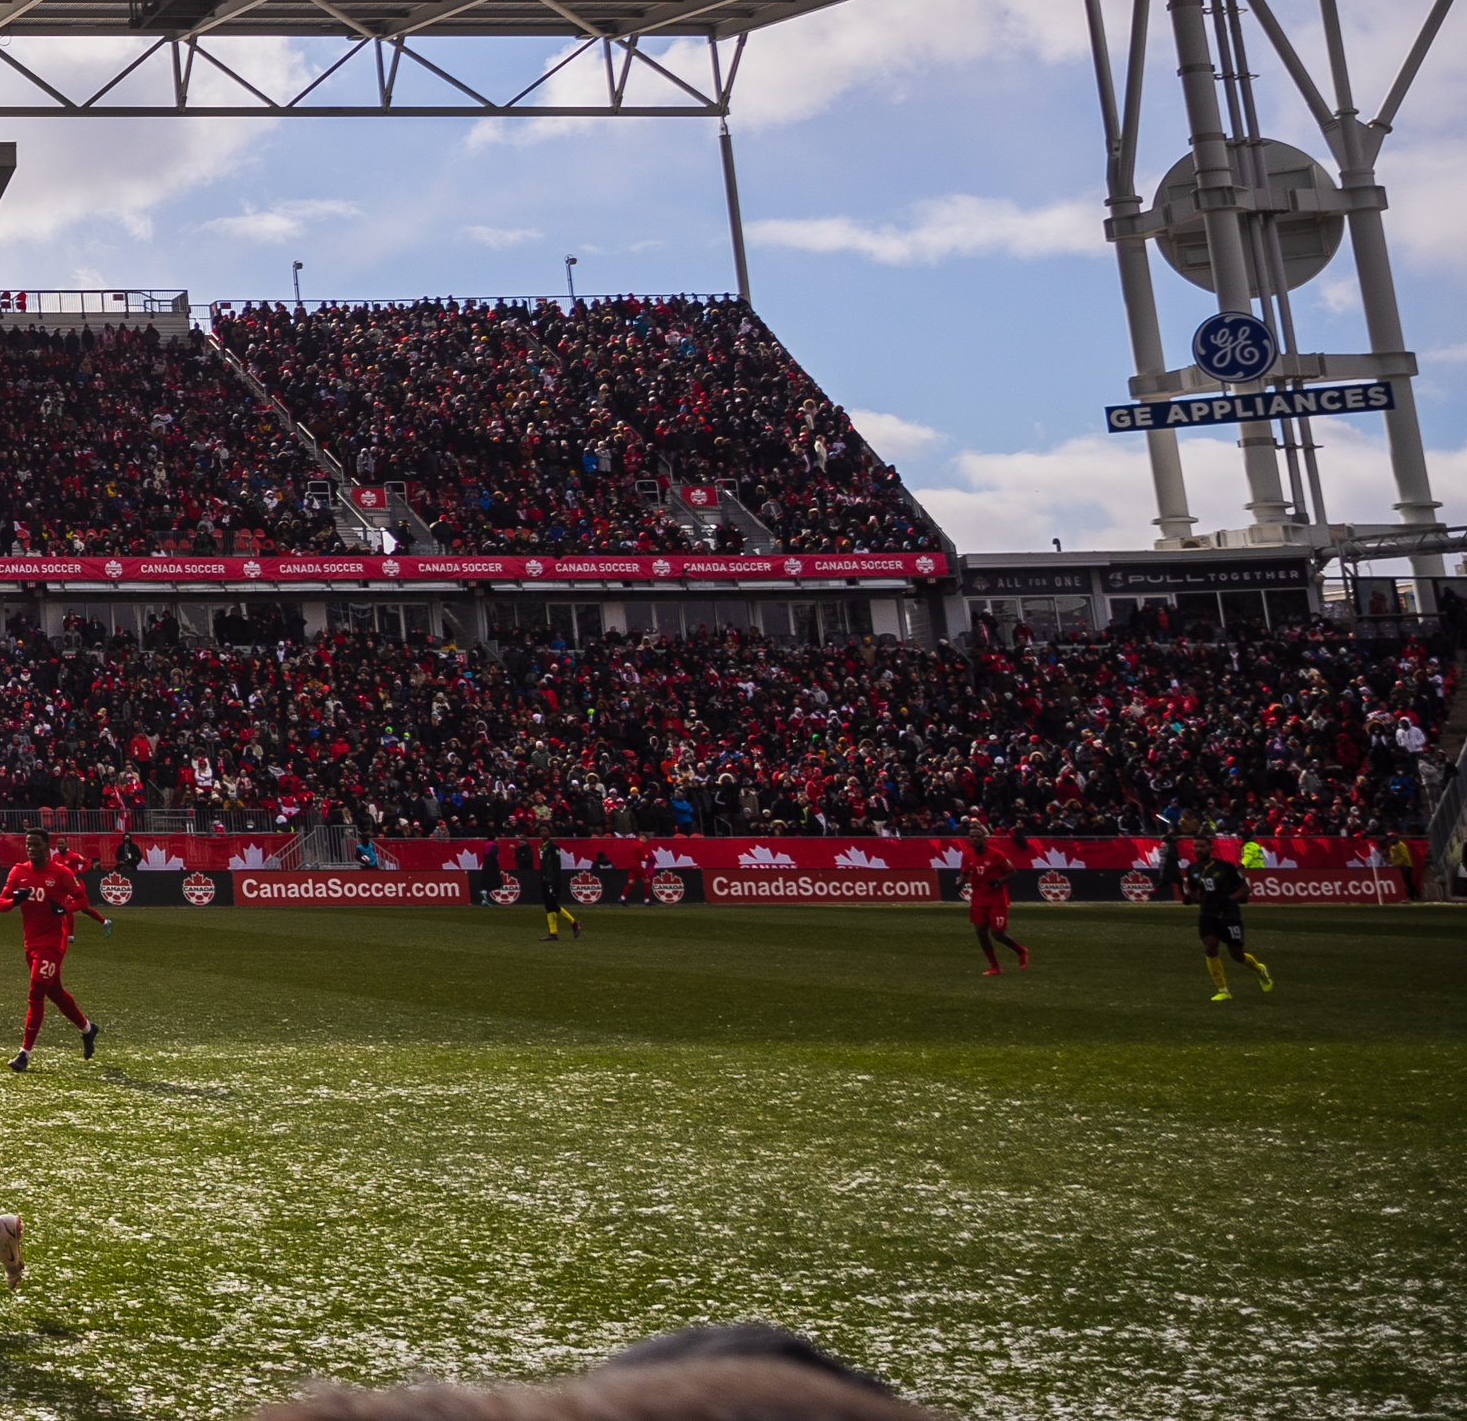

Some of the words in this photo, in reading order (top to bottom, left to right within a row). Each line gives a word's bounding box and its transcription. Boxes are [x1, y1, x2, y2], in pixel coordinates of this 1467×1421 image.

[1109, 406, 1154, 429] GE
[1166, 386, 1388, 424] APPLIANCES
[42, 563, 81, 574] SOCCER
[141, 563, 183, 574] CANADA
[186, 563, 225, 574] SOCCER
[280, 563, 321, 574] CANADA
[324, 563, 363, 574] SOCCER
[418, 562, 460, 573] CANADA
[463, 562, 502, 573] SOCCER
[556, 563, 597, 573] CANADA
[600, 563, 639, 573] SOCCER
[683, 562, 727, 572] CANADA
[730, 562, 771, 572] SOCCER
[815, 561, 859, 572] CANADA
[862, 561, 903, 572] SOCCER
[997, 577, 1020, 588] ALL
[1054, 576, 1081, 587] ONE
[1128, 575, 1204, 584] PULL
[1207, 570, 1299, 581] TOGETHER
[241, 878, 460, 898] CanadaSoccer.com
[712, 876, 930, 896] CanadaSoccer.com
[1203, 878, 1215, 891] 19
[28, 886, 46, 902] 20
[1228, 925, 1241, 940] 19
[39, 959, 56, 977] 20
